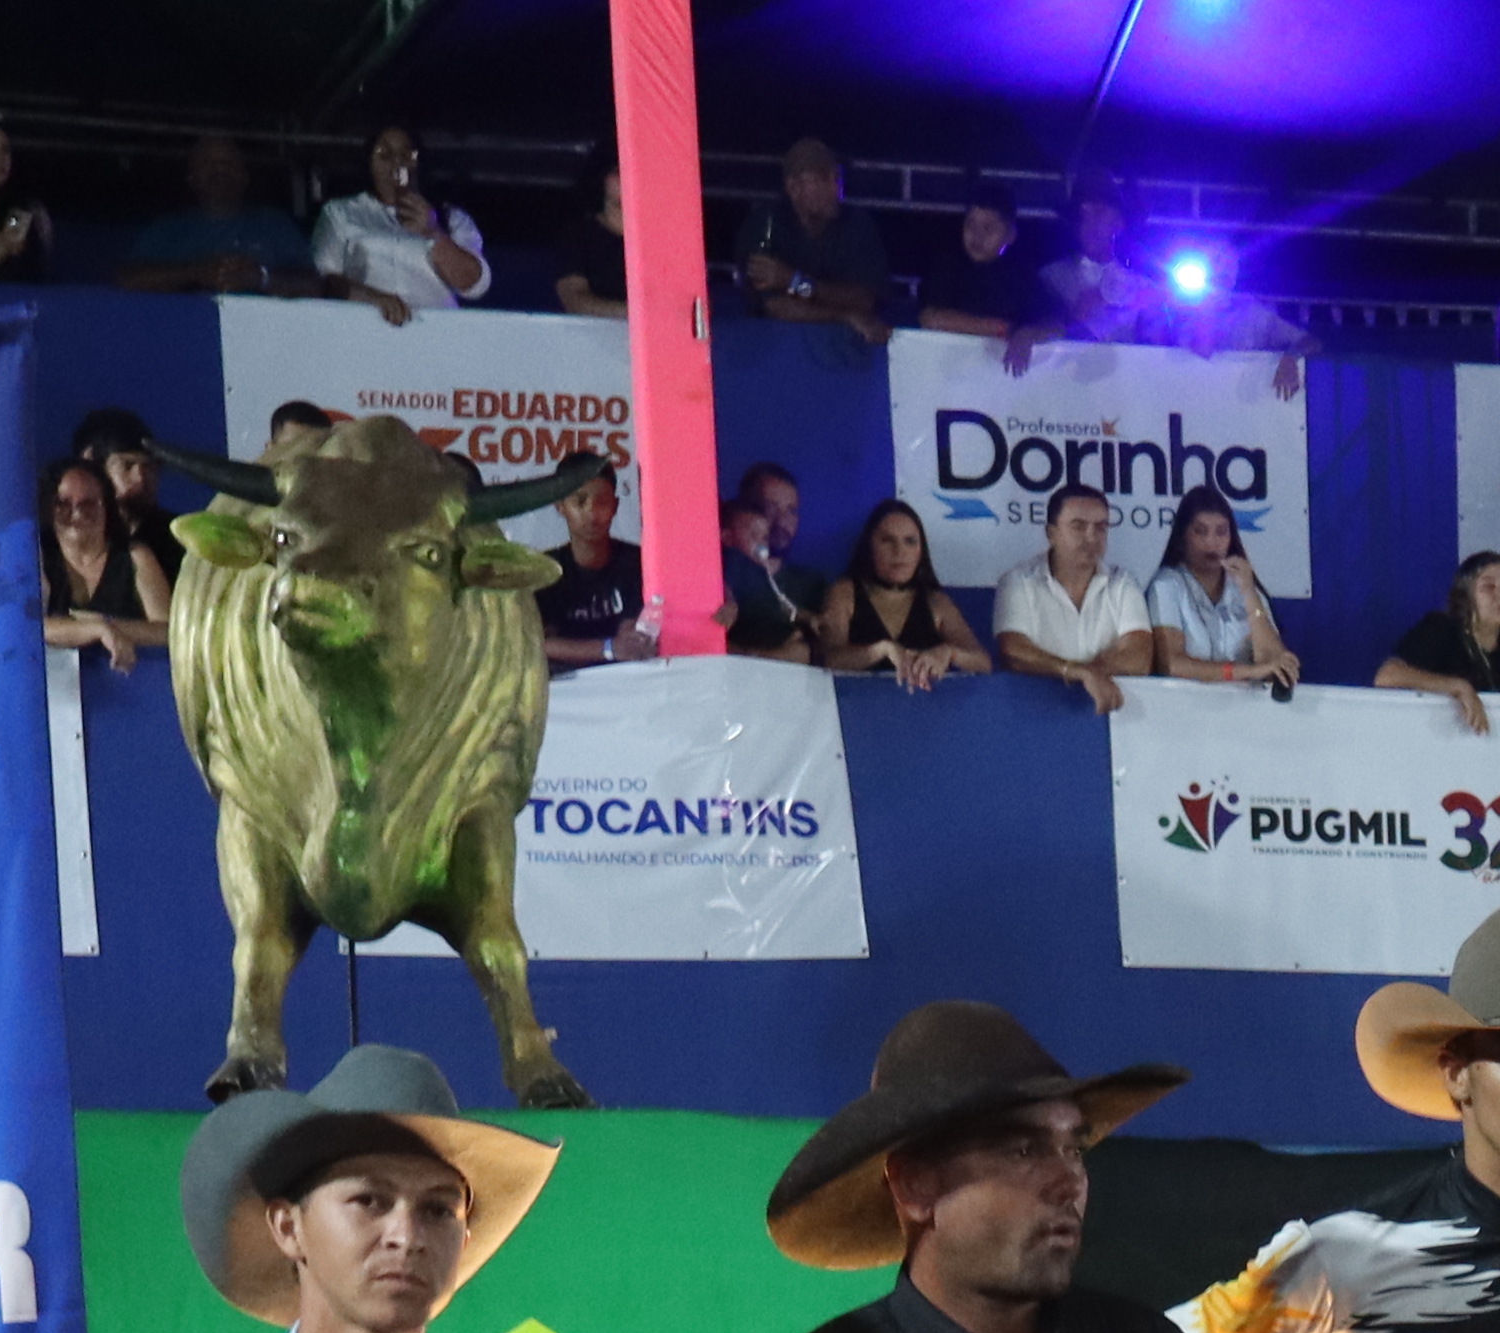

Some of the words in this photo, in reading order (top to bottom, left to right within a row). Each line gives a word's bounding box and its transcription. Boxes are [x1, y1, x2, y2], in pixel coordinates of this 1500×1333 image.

[357, 389, 447, 411] SENADOR
[453, 388, 630, 425] EDUARDO
[1007, 416, 1101, 437] Professora
[468, 425, 632, 469] GOMES
[936, 408, 1267, 501] Dorinha
[534, 777, 614, 793] OVERNO
[620, 777, 647, 792] DO
[527, 797, 820, 838] TOCANTINS
[1250, 807, 1428, 848] PUGMIL
